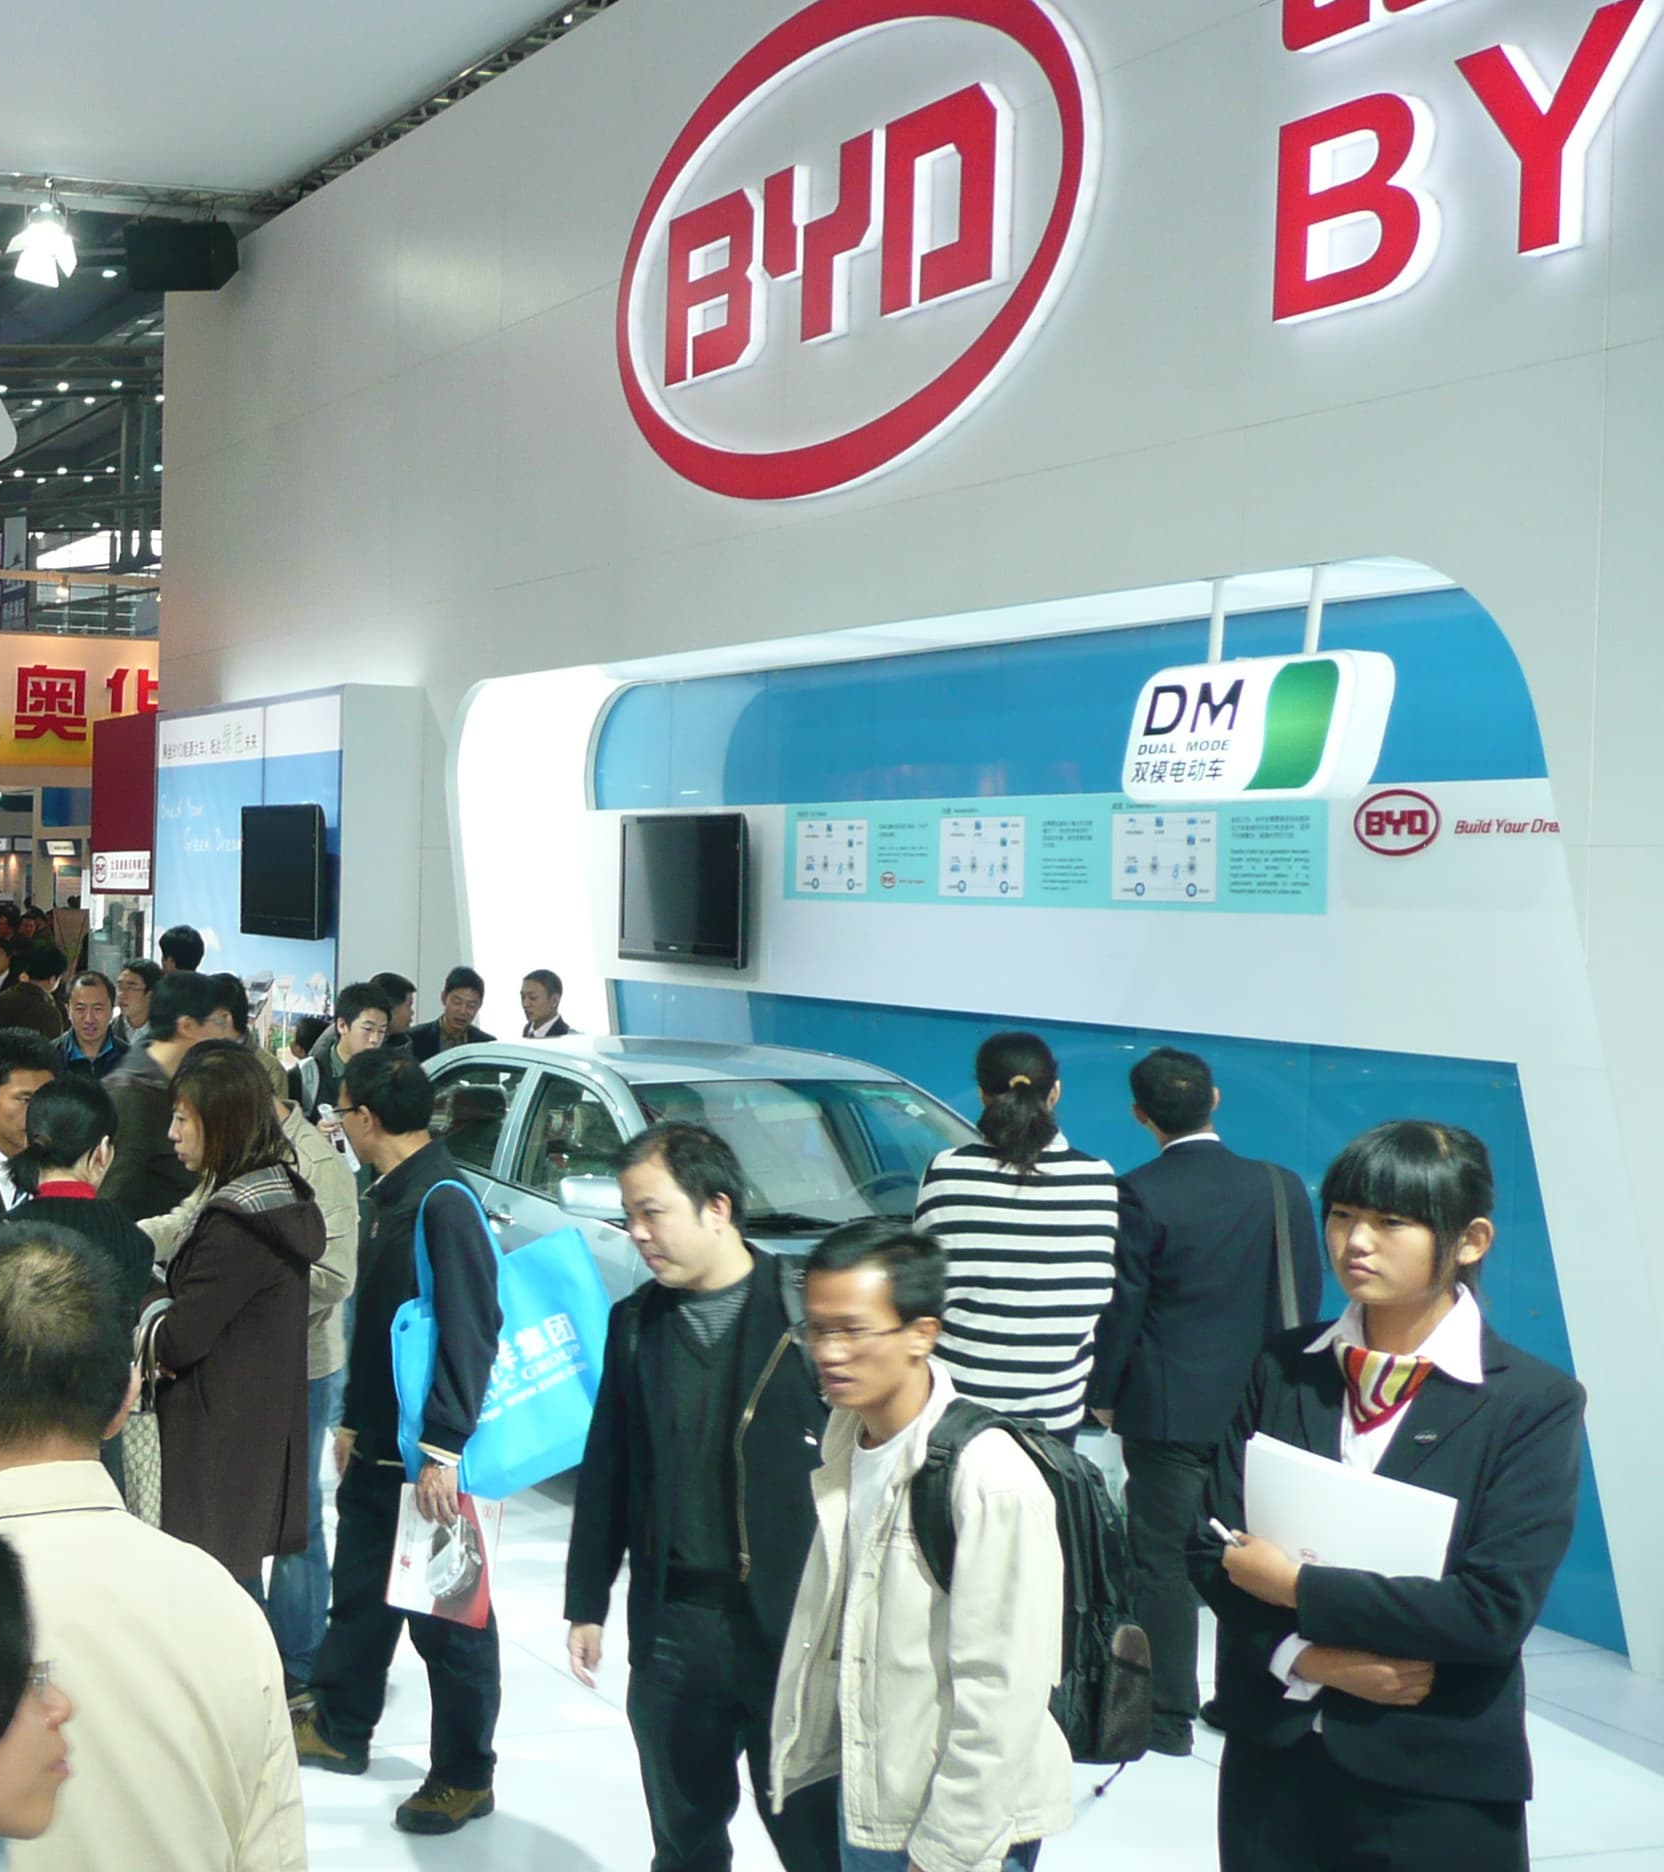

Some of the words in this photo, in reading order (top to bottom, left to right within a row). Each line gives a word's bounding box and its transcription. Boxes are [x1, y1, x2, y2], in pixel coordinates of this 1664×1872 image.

[664, 82, 1014, 388] BYD
[1143, 679, 1245, 736] DM
[1137, 743, 1177, 756] DUAL
[1186, 739, 1231, 753] MODE
[1130, 758, 1226, 784] 双模电动车
[1365, 809, 1429, 836] BYD
[1454, 819, 1492, 835] Build
[1494, 818, 1527, 834] Your
